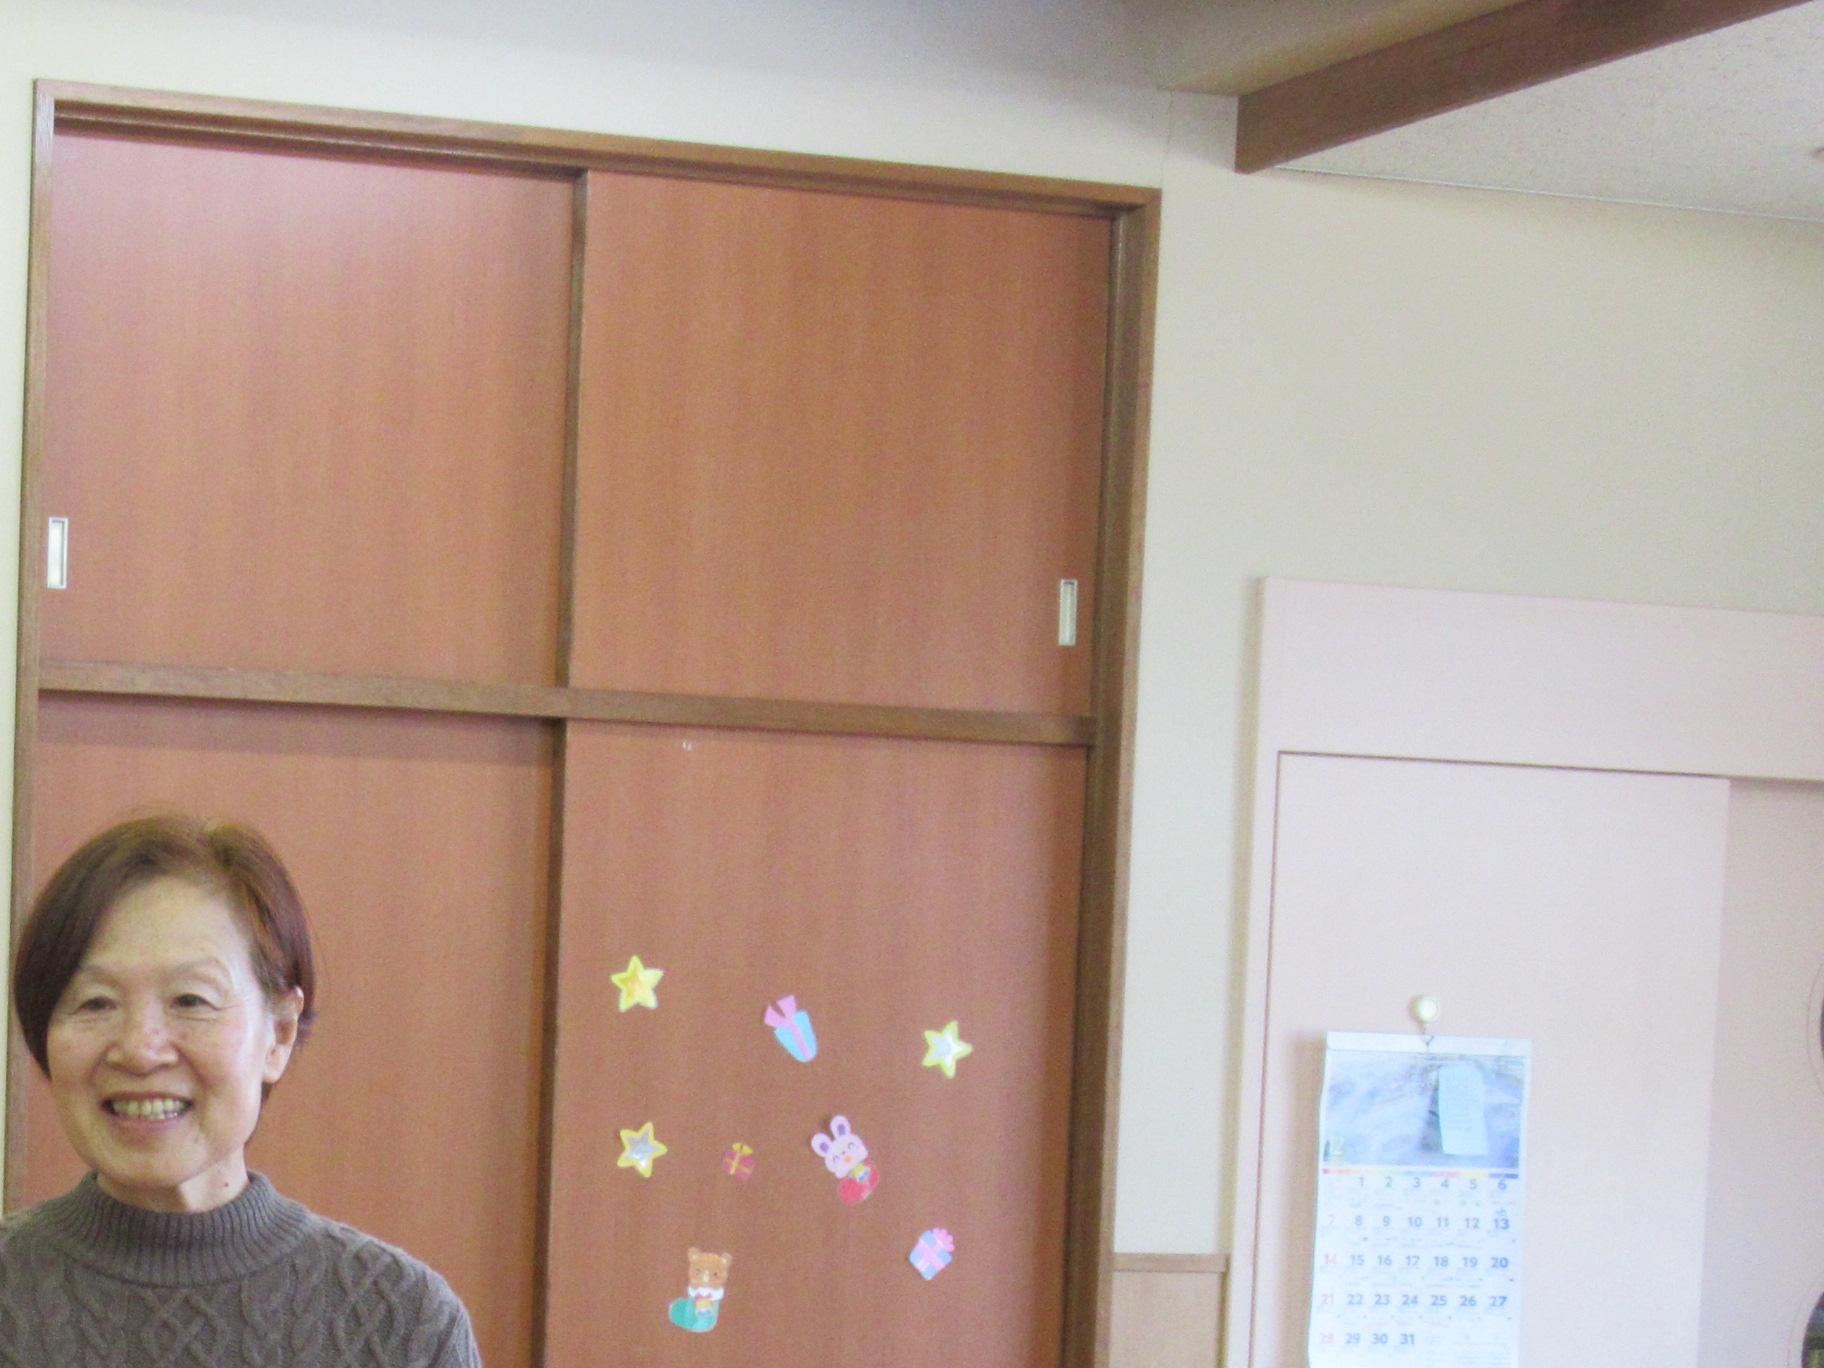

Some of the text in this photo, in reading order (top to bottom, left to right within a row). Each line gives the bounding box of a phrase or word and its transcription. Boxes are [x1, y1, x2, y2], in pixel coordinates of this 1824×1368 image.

[1358, 1177, 1507, 1190] 1 2 3 4 5 6
[1355, 1216, 1363, 1226] 8
[1383, 1216, 1390, 1226] 9
[1408, 1217, 1422, 1227] 10
[1437, 1217, 1449, 1227] 11
[1465, 1218, 1479, 1229] 12
[1494, 1218, 1510, 1229] 13
[1350, 1255, 1364, 1265] 15
[1377, 1255, 1392, 1265] 16
[1406, 1255, 1420, 1266] 17
[1434, 1256, 1448, 1267] 18
[1463, 1257, 1478, 1268] 19
[1491, 1257, 1509, 1268] 20
[1347, 1294, 1363, 1305] 22
[1375, 1294, 1390, 1305] 23
[1402, 1295, 1418, 1305] 24
[1431, 1296, 1447, 1306] 25
[1460, 1296, 1476, 1306] 26
[1489, 1296, 1507, 1307] 27
[1344, 1333, 1360, 1344] 29
[1372, 1334, 1388, 1344] 30
[1400, 1334, 1415, 1344] 31
